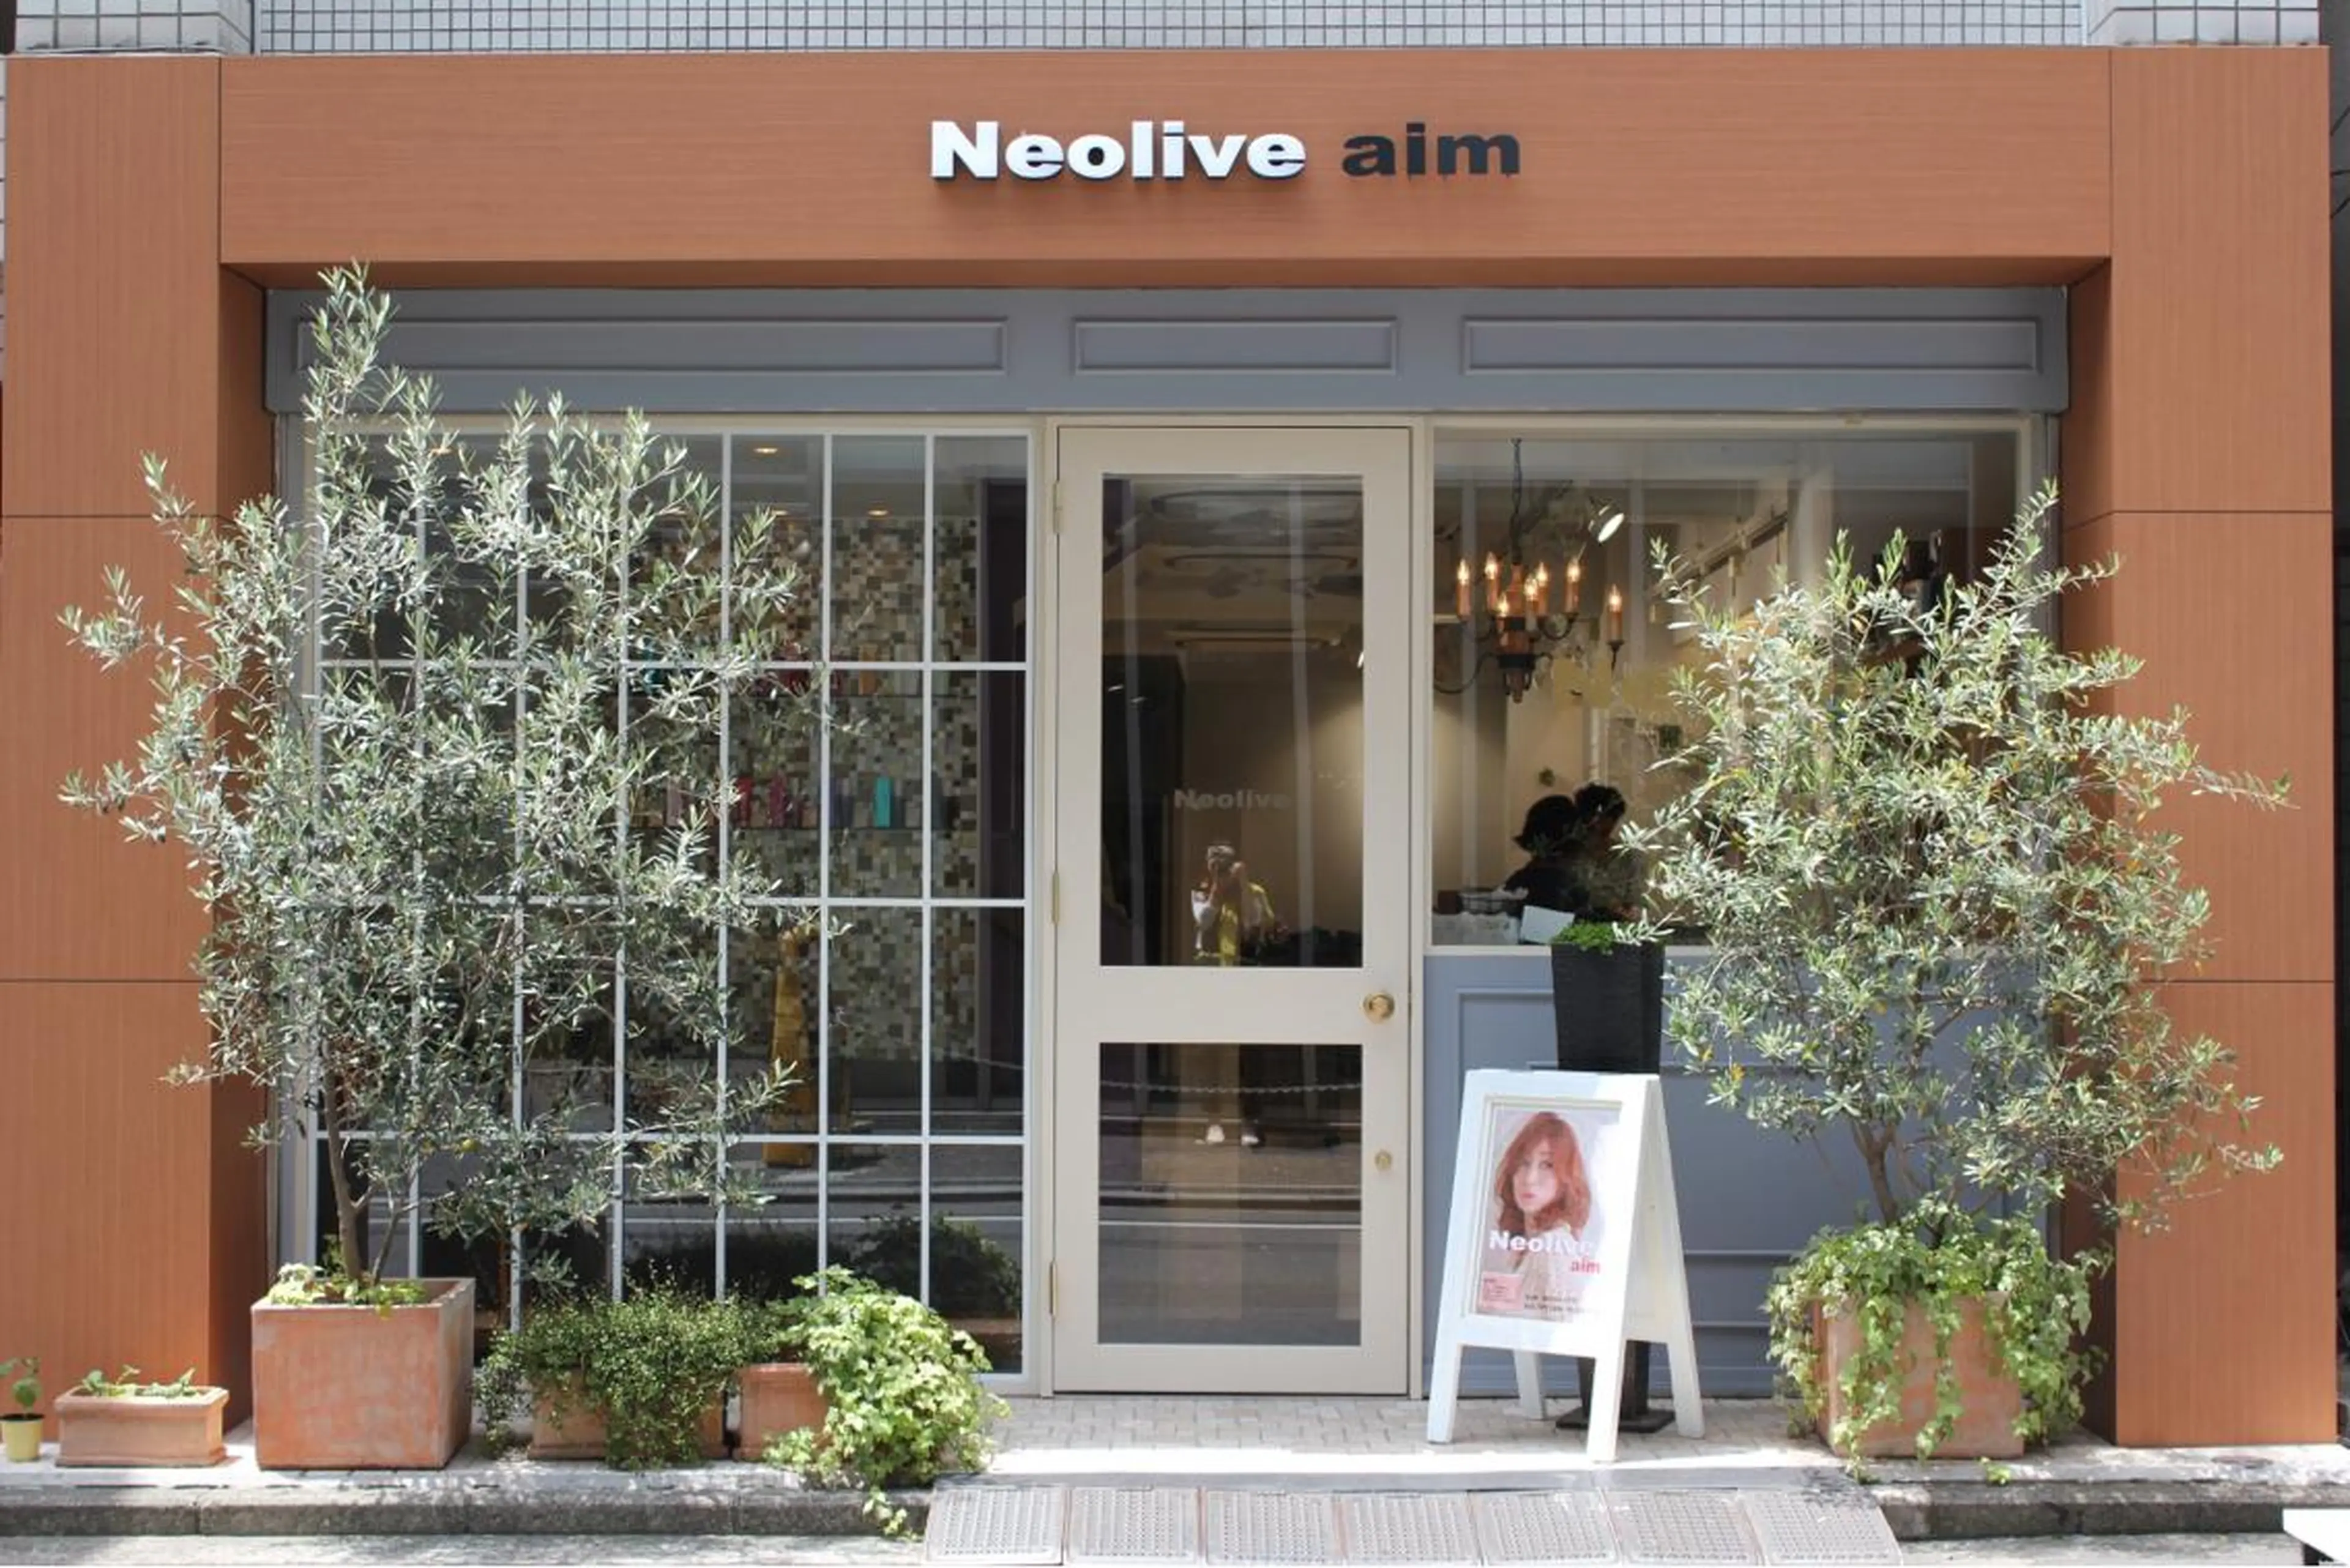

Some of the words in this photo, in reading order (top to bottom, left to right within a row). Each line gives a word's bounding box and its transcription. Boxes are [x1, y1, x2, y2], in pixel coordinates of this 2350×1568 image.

[930, 120, 1306, 181] Neolive
[1342, 122, 1521, 177] aim
[1174, 788, 1293, 811] Neolive
[1570, 1256, 1601, 1275] aim
